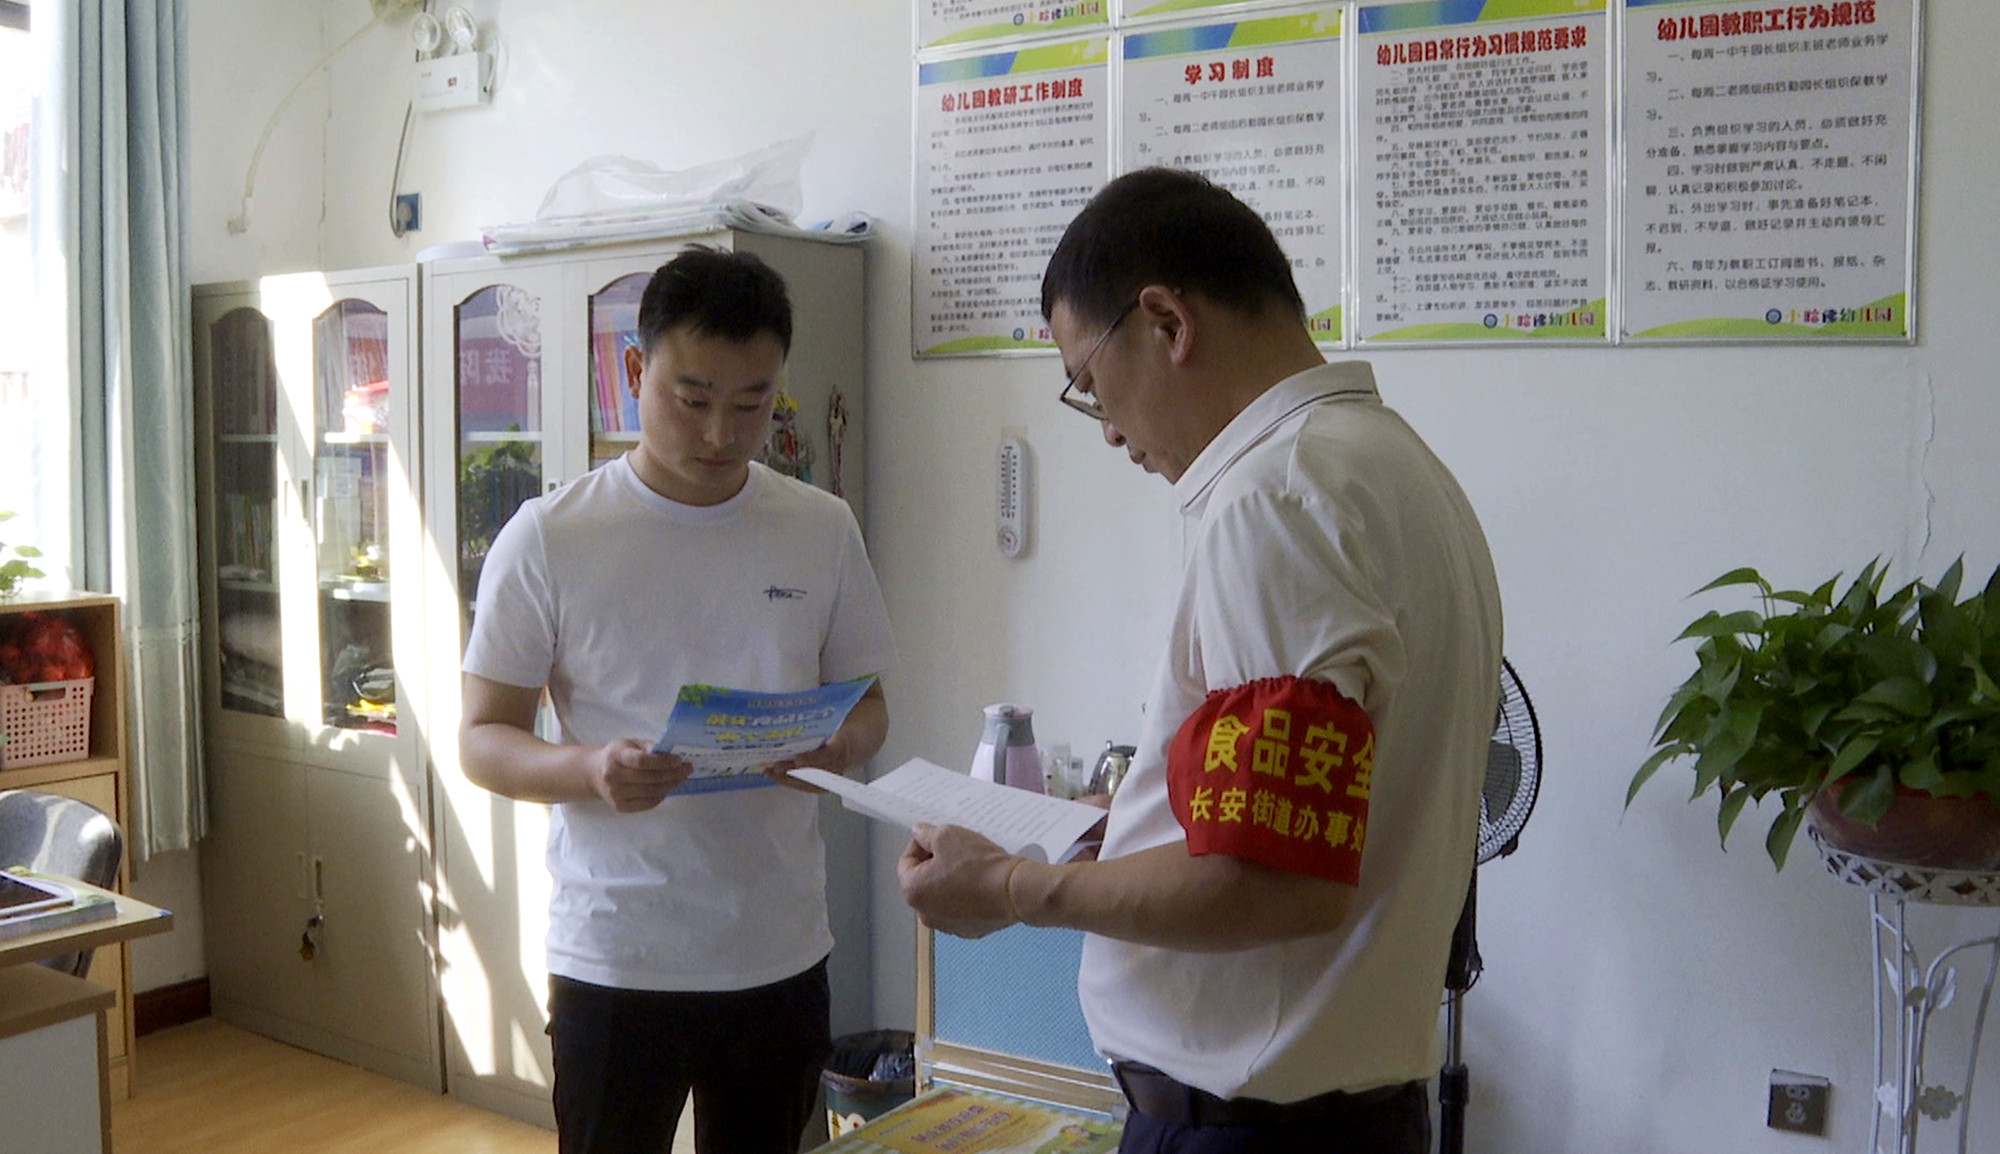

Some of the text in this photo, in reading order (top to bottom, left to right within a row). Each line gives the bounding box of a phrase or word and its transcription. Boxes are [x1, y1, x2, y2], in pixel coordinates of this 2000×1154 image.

[1657, 0, 1876, 41] 幼儿园教职工行为规范
[1377, 26, 1587, 66] 幼儿园日常行为习惯规范要求
[1184, 56, 1275, 85] 学习制度
[942, 78, 1083, 112] 幼儿园教研工作制度
[1204, 708, 1374, 801] 食品安全
